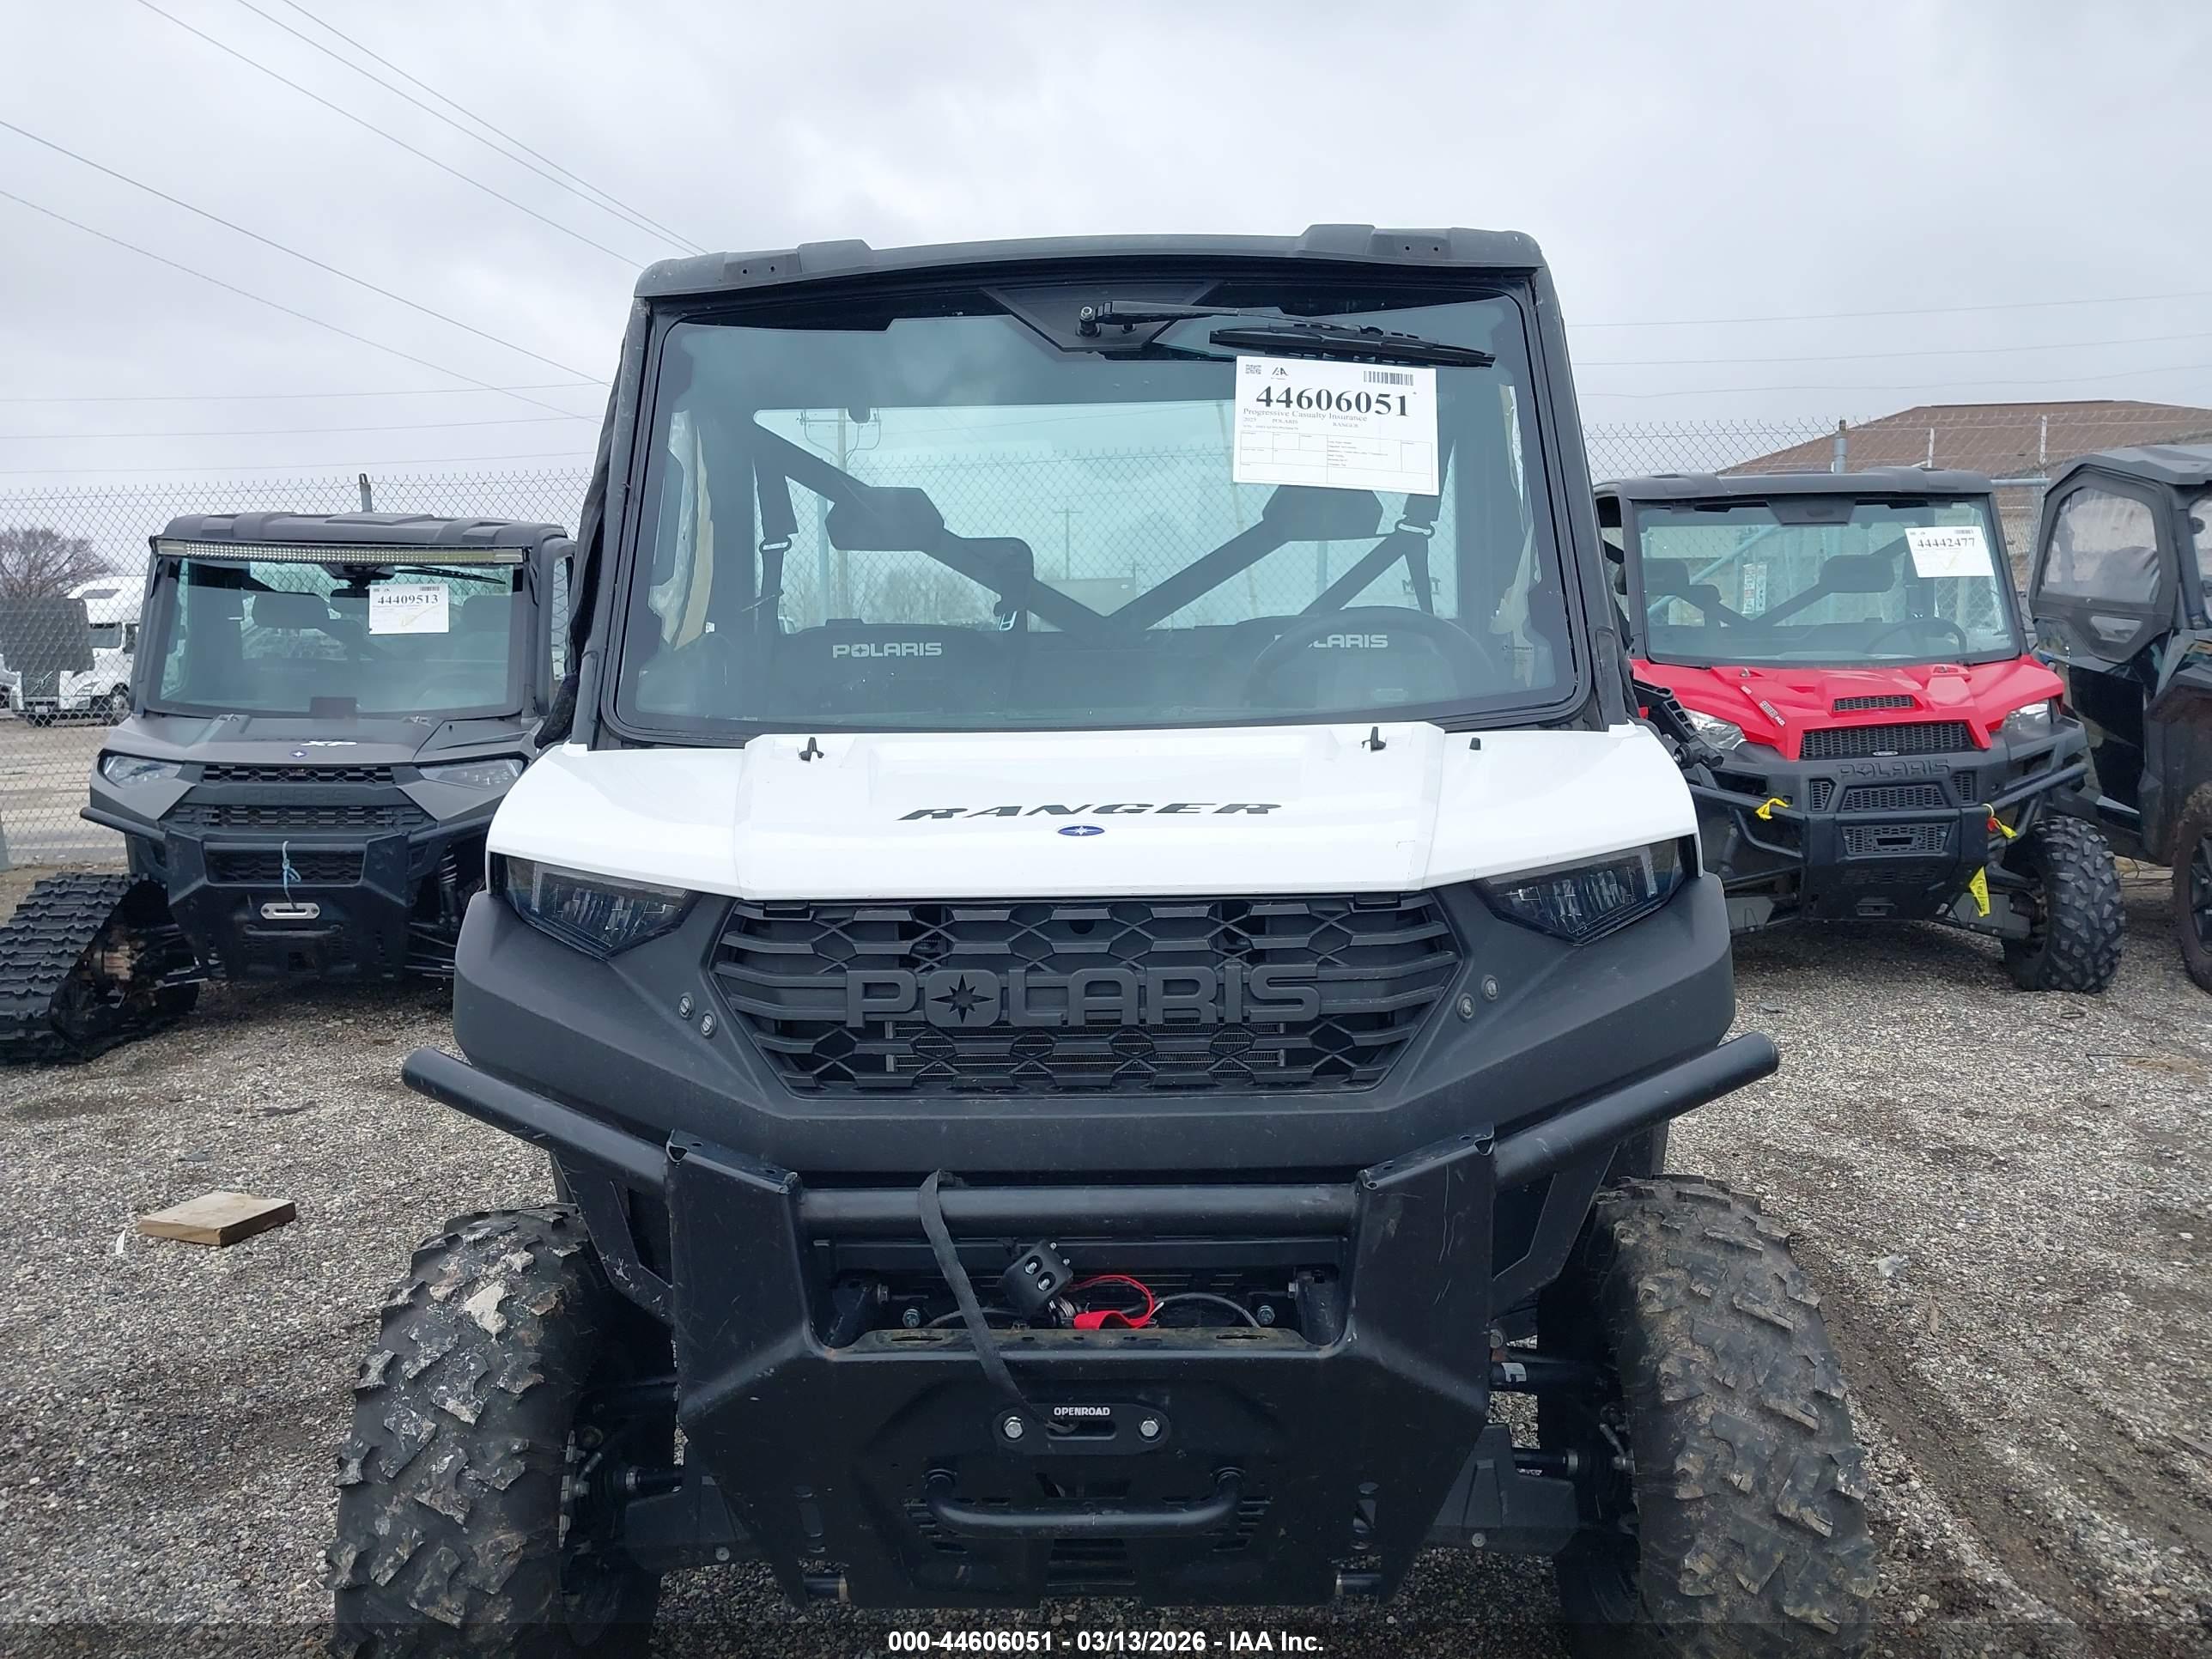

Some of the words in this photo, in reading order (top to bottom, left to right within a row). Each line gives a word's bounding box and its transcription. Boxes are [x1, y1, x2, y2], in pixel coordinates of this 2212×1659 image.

[1256, 386, 1410, 417] 44606051
[1243, 408, 1290, 417] Progressive
[1291, 410, 1327, 420] Casualty
[1329, 412, 1367, 422] Insurance
[1917, 538, 1975, 548] 44442477
[378, 594, 439, 605] 44409513
[832, 641, 943, 658] POLARIS
[1838, 759, 1950, 779] POLARIS
[894, 803, 1283, 821] RANGER
[845, 963, 1321, 1029] POLARIS
[1054, 1406, 1110, 1417] OPENROAD
